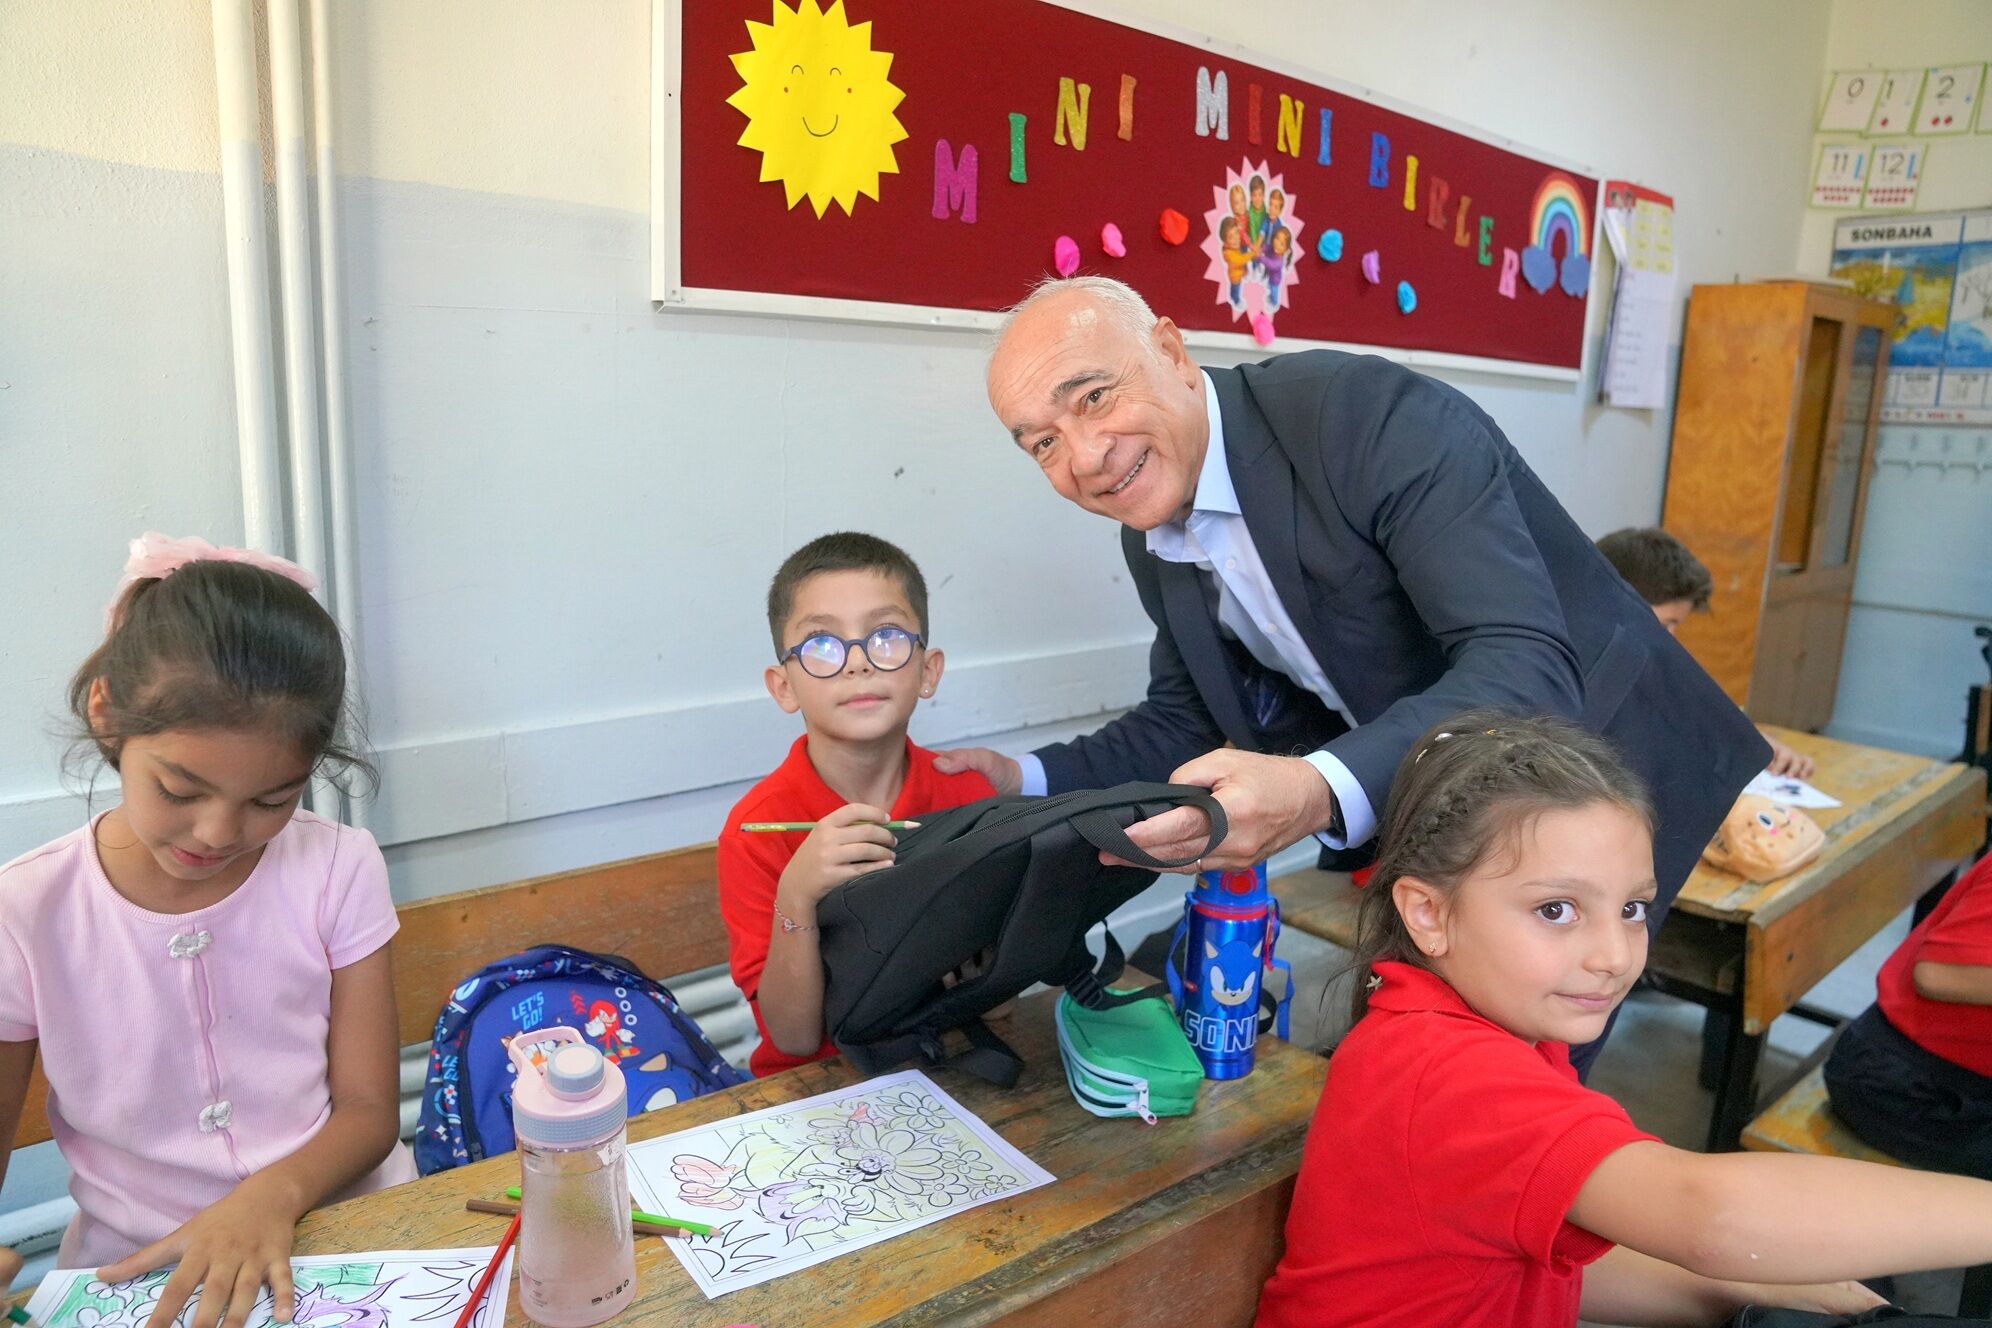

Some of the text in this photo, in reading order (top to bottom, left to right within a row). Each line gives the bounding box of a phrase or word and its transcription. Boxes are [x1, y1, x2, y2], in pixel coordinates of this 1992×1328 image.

[1848, 77, 1865, 98] 0
[1886, 79, 1894, 99] 1
[1936, 75, 1955, 99] 2
[1832, 153, 1849, 173] 11
[1880, 152, 1905, 175] 12
[932, 73, 1137, 223] MINI
[1195, 66, 1333, 166] MINI
[1368, 132, 1519, 299] BIRLER
[511, 991, 545, 1021] LET'S
[522, 1008, 544, 1030] GO!
